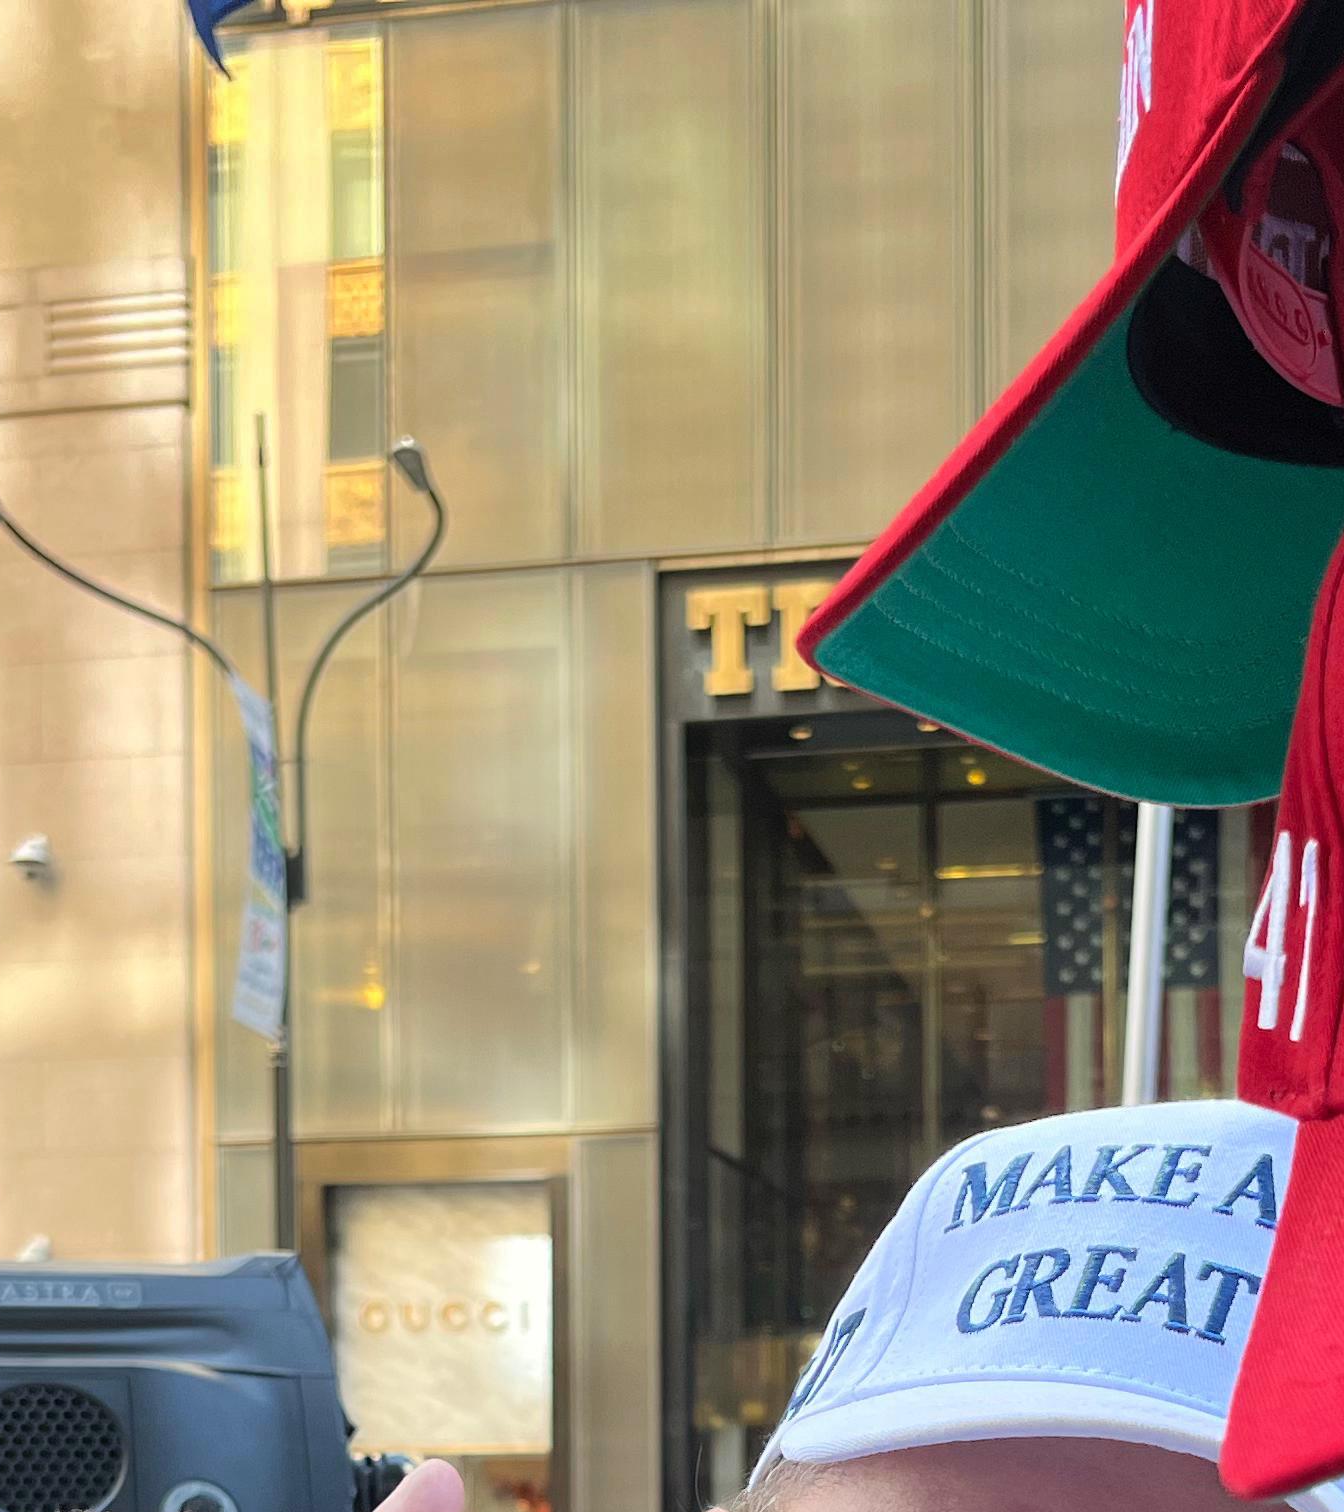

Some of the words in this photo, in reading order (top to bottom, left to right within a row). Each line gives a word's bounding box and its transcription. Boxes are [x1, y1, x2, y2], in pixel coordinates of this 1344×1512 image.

[943, 1143, 1212, 1235] MAKE
[359, 1298, 530, 1337] GUCCI
[956, 1244, 1261, 1346] GREAT
